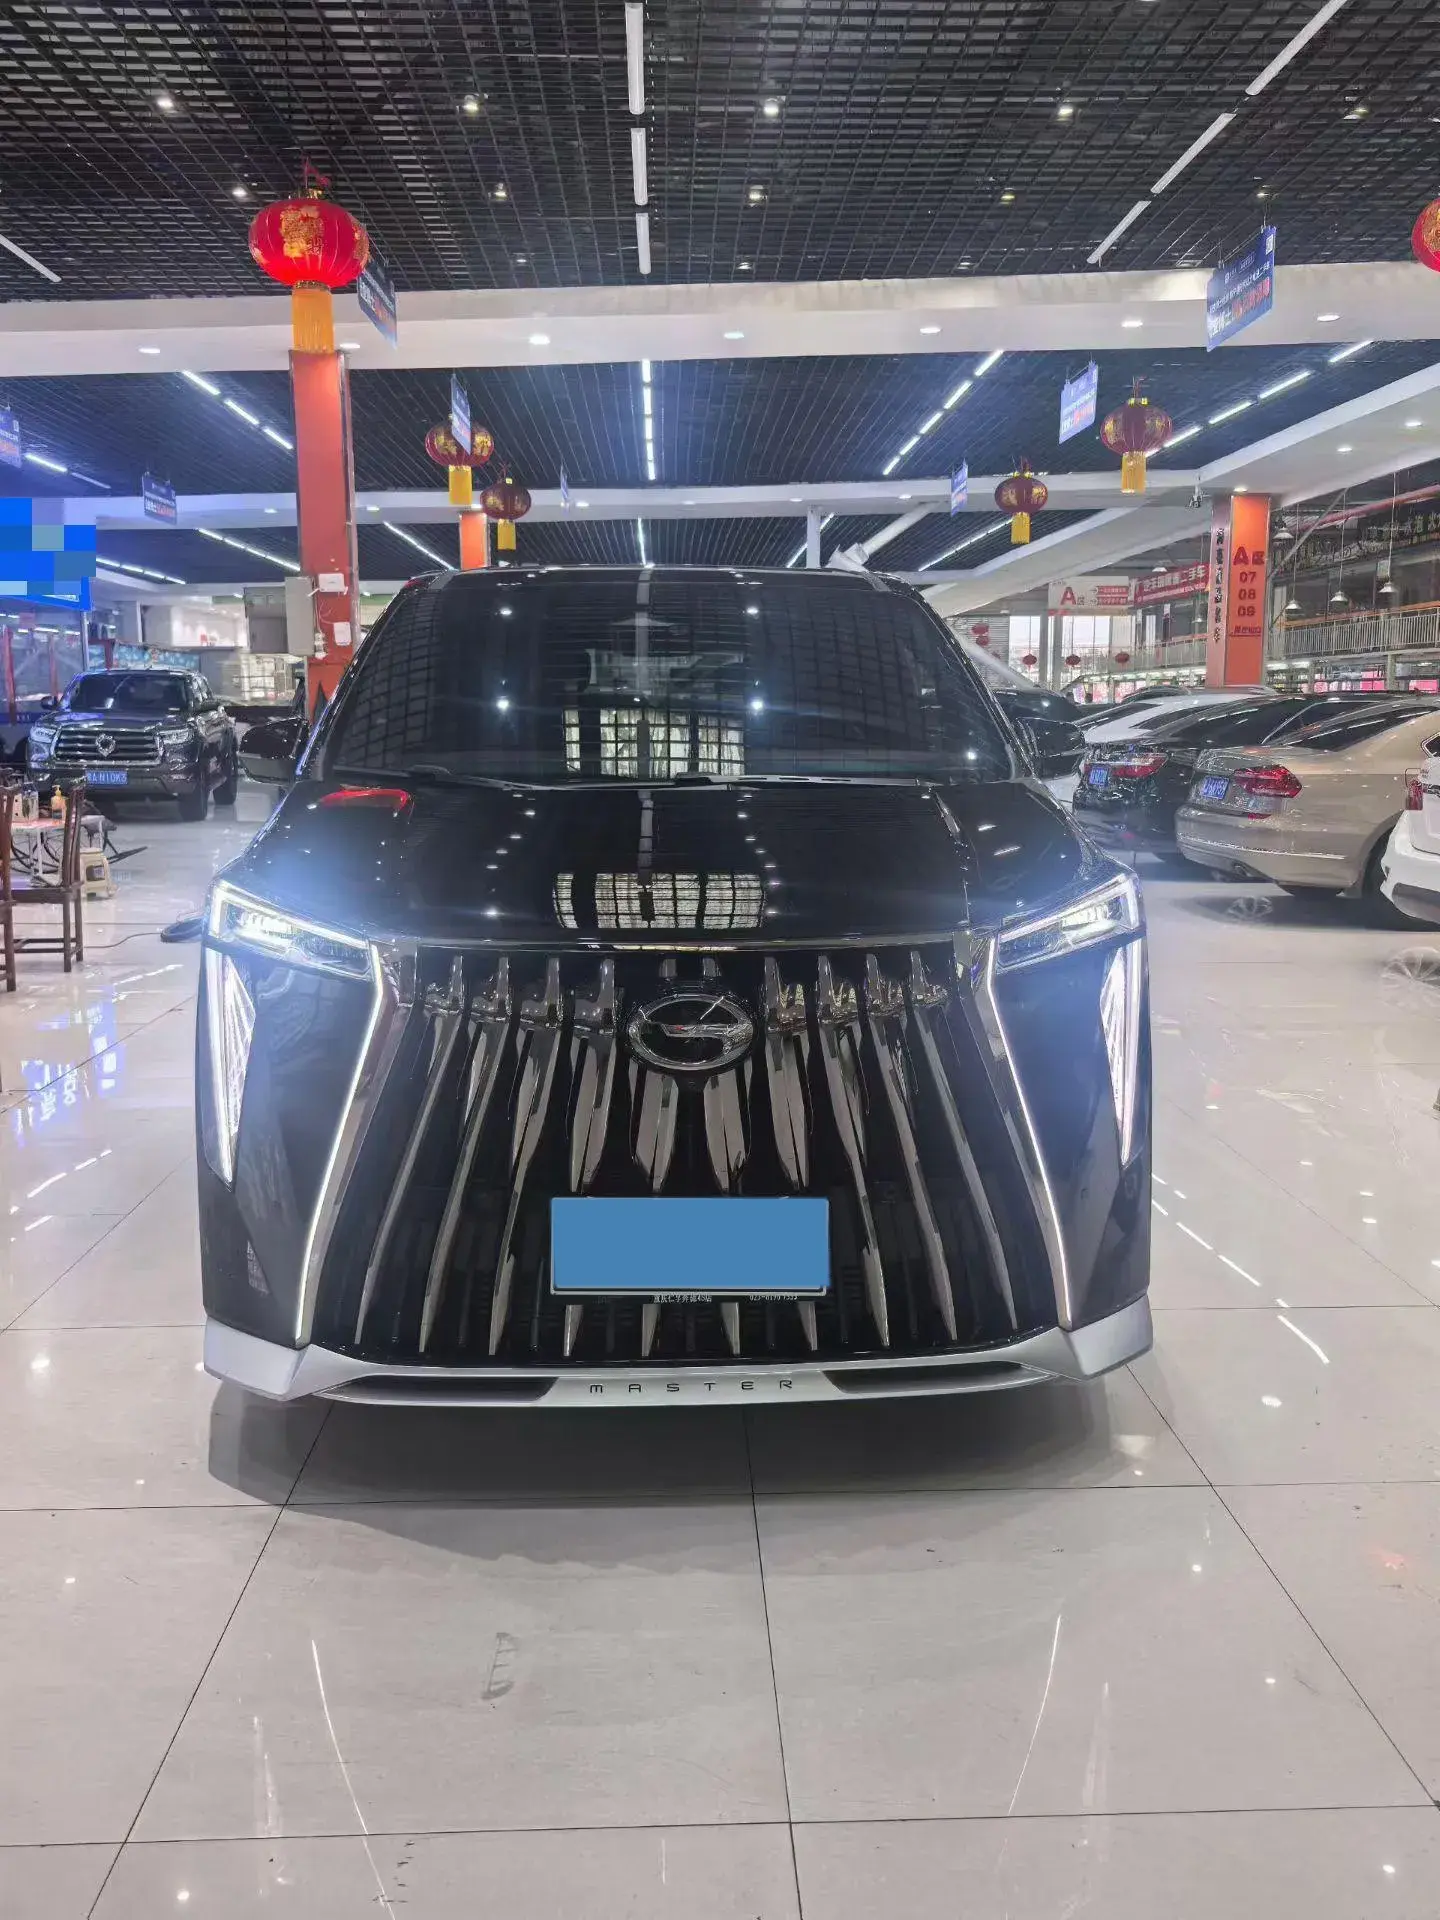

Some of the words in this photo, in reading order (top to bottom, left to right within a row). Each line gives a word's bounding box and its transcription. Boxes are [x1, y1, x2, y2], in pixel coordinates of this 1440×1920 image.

[1233, 546, 1265, 566] A区
[1239, 571, 1257, 583] 07
[1238, 588, 1256, 600] 08
[1237, 605, 1256, 617] 09
[589, 1379, 793, 1394] MASTER
